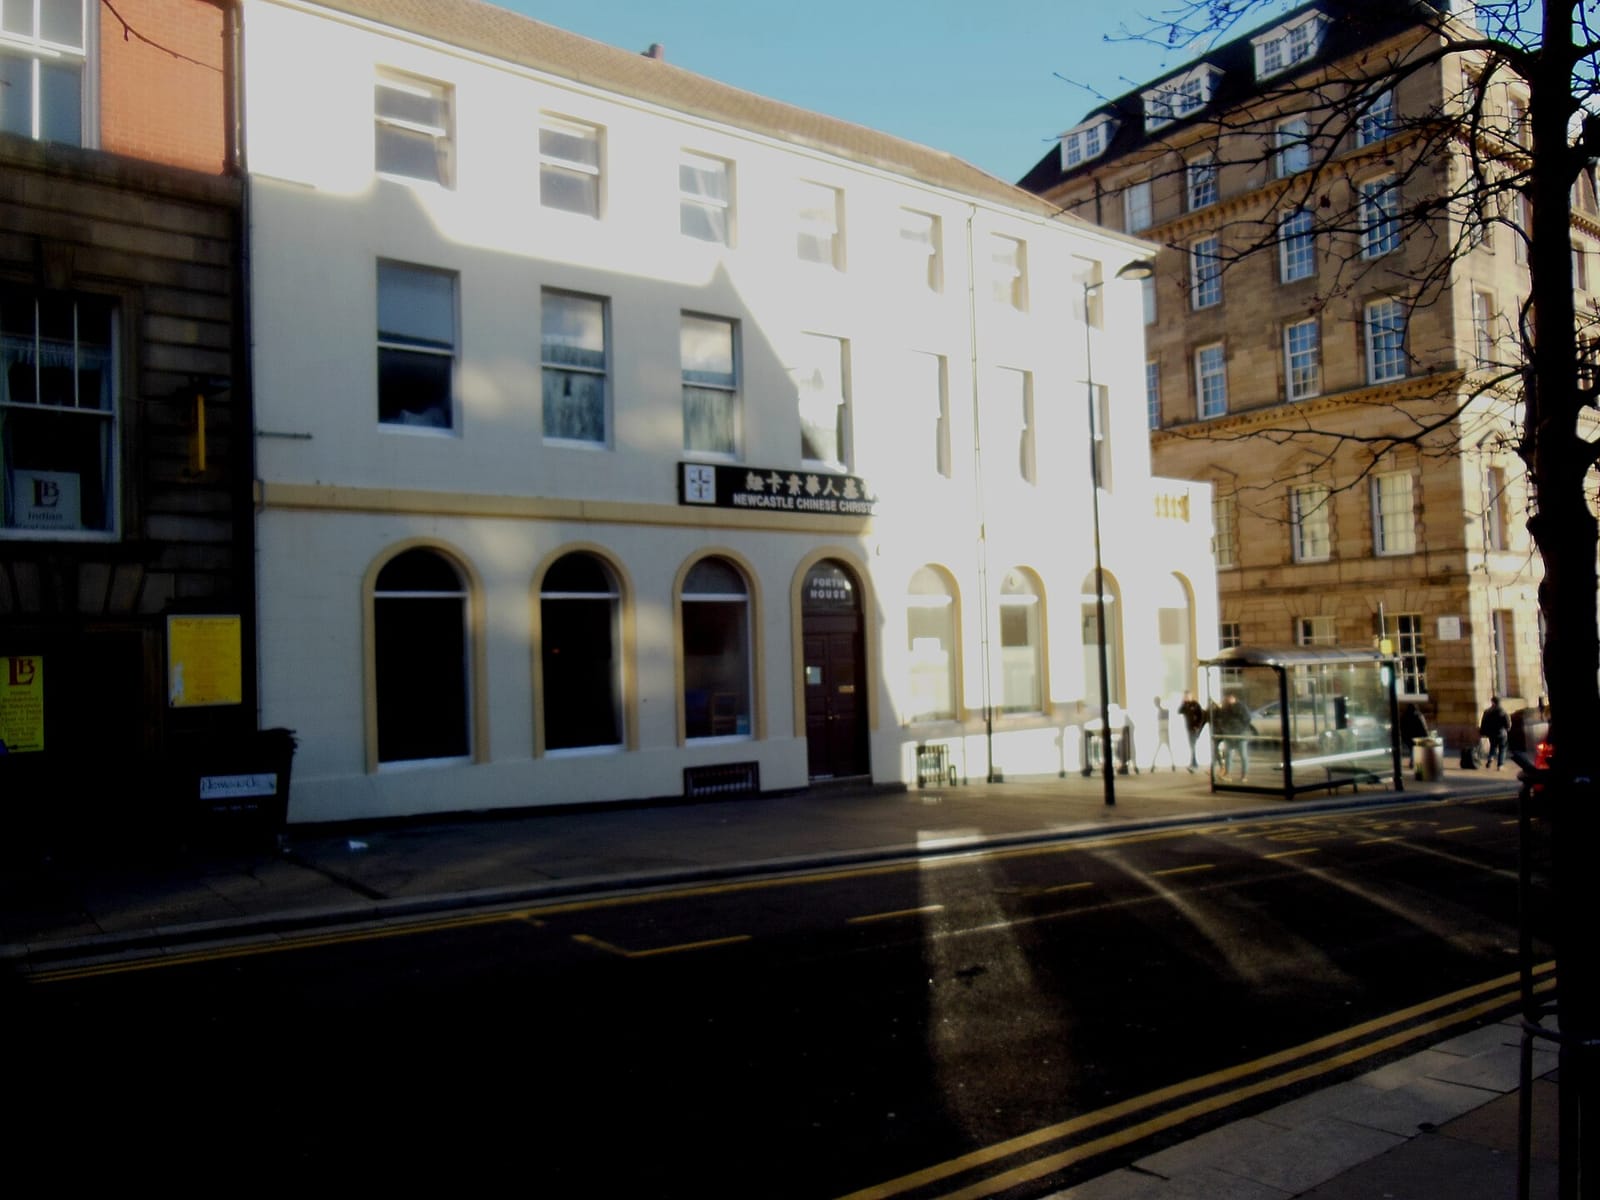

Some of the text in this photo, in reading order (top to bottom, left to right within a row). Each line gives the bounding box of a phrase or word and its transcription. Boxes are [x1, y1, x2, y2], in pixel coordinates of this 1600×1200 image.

[733, 493, 794, 509] NEWCASTLE
[796, 497, 837, 511] CHINESE
[810, 589, 846, 599] HOUSE
